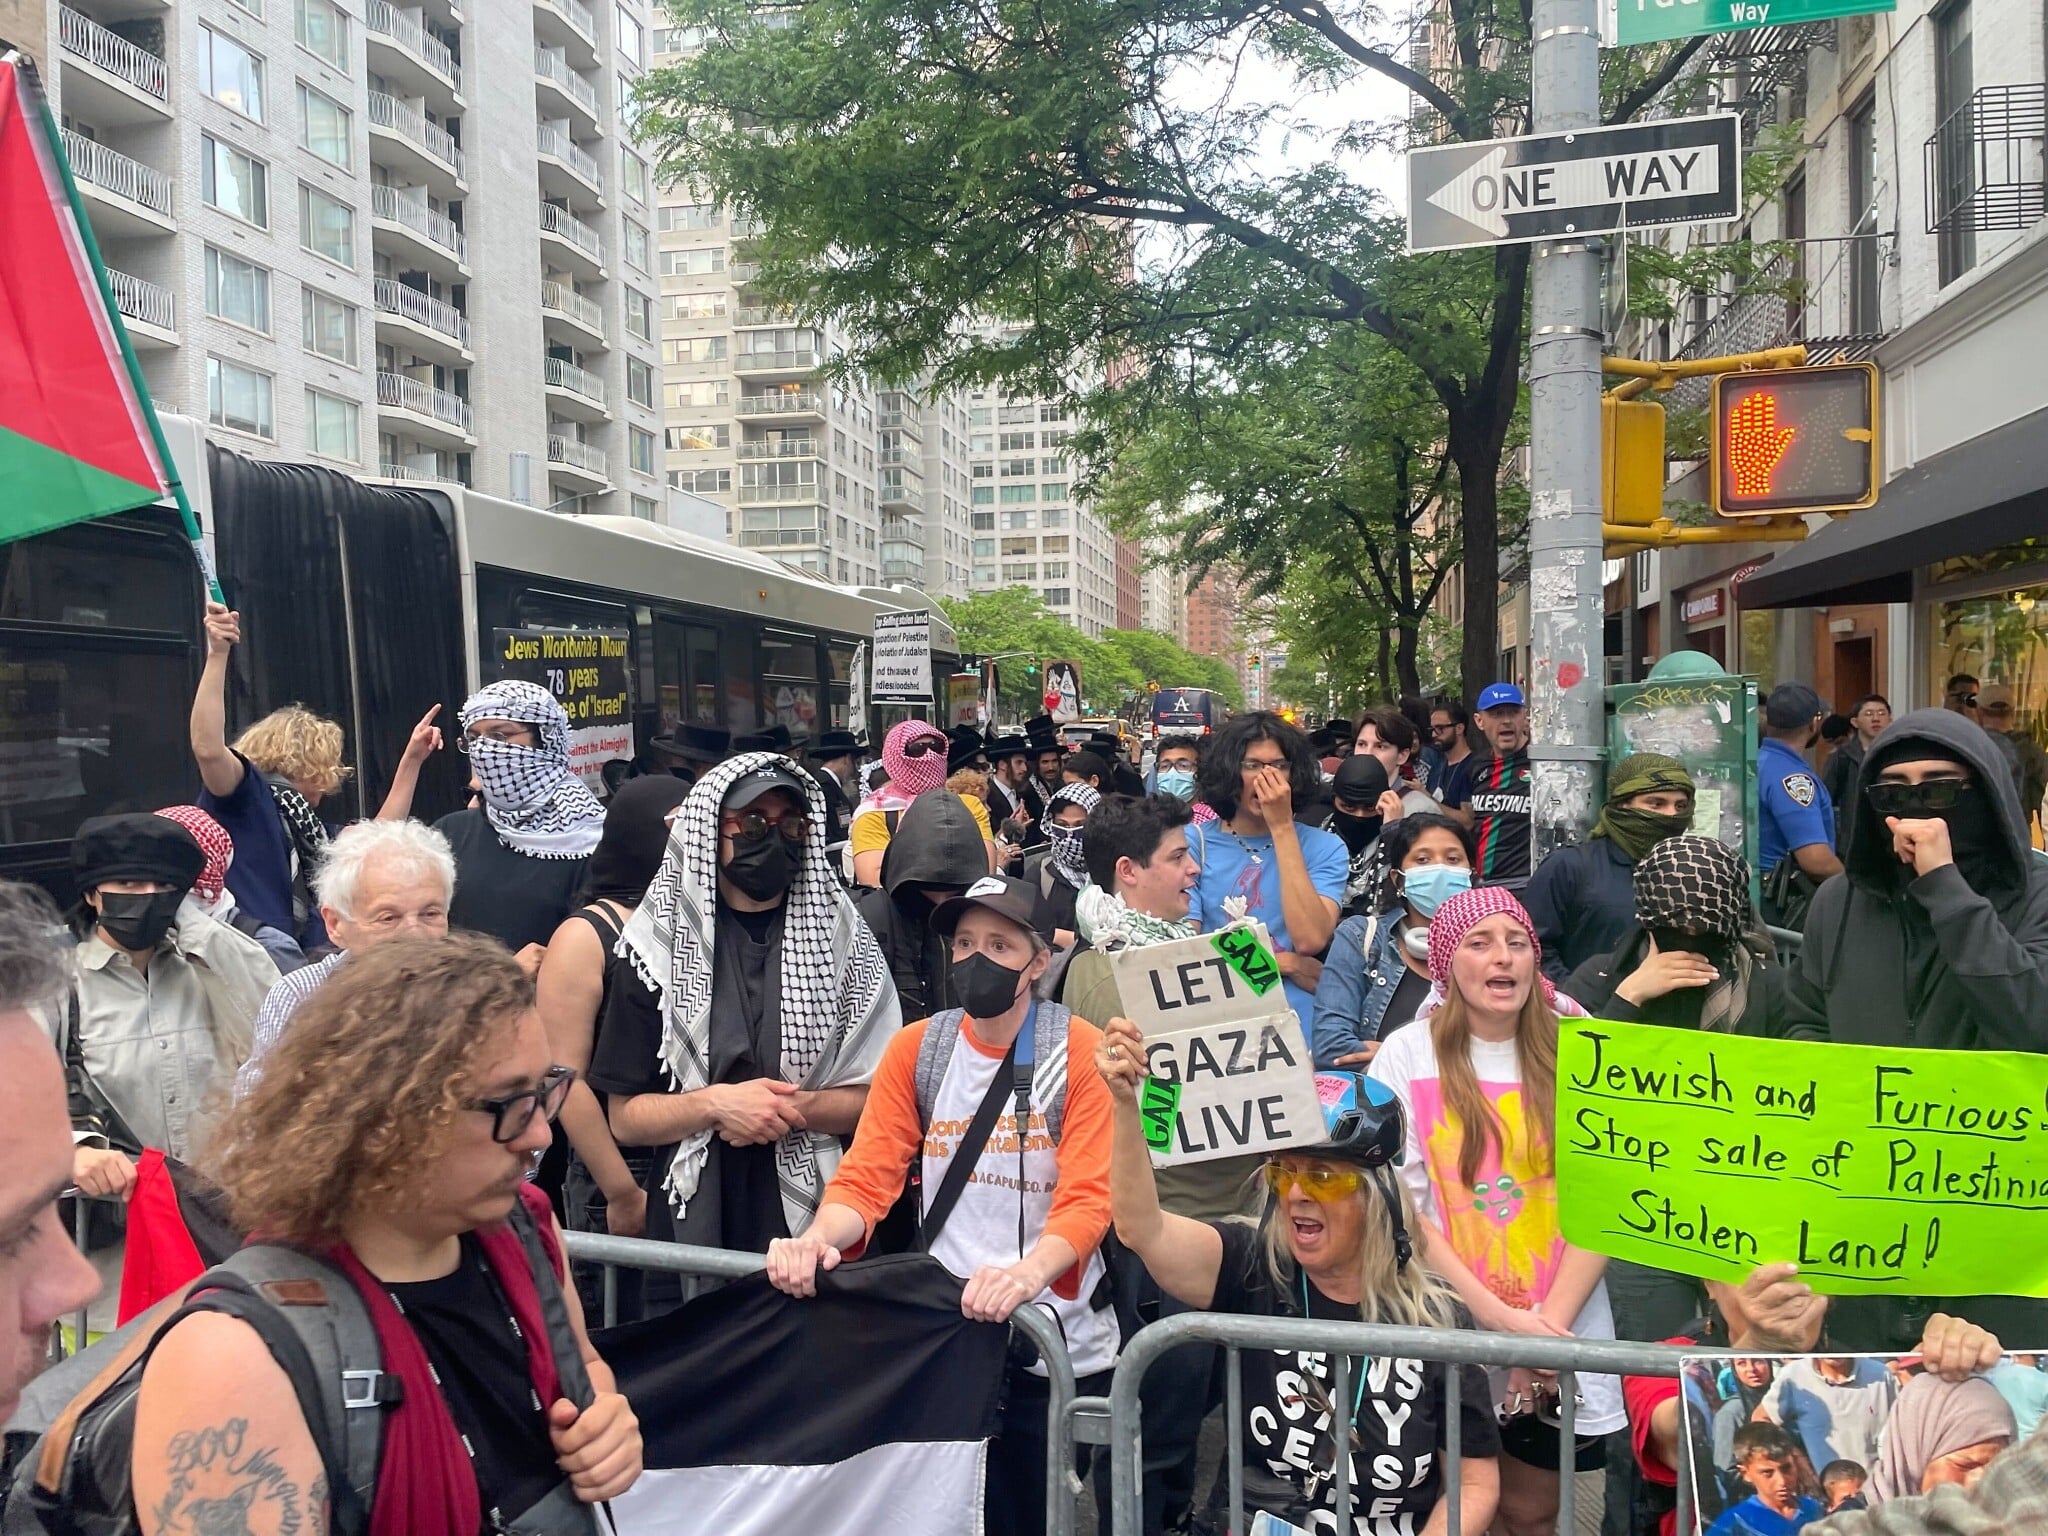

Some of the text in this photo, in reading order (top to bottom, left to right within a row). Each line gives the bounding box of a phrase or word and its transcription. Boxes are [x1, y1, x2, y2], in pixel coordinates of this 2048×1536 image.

[1731, 3, 1770, 24] Way
[1472, 152, 1701, 212] ONE WAY
[1660, 211, 1732, 223] TRANSPORTATION
[505, 635, 540, 660] Jews
[542, 635, 598, 658] Worldwide
[903, 632, 928, 643] Palestine
[547, 667, 598, 696] 78 years
[579, 695, 590, 719] of
[1472, 794, 1531, 814] ALESTINE
[1149, 957, 1235, 1011] LET
[1145, 1025, 1297, 1083] GAZA
[1570, 1031, 1733, 1104] Jewish
[1754, 1080, 1817, 1116] and
[1176, 1095, 1292, 1154] LIVE
[1570, 1107, 1671, 1173] Stop
[1698, 1134, 1786, 1172] sale
[1811, 1140, 1853, 1179] of
[1618, 1189, 1758, 1256] Stolen
